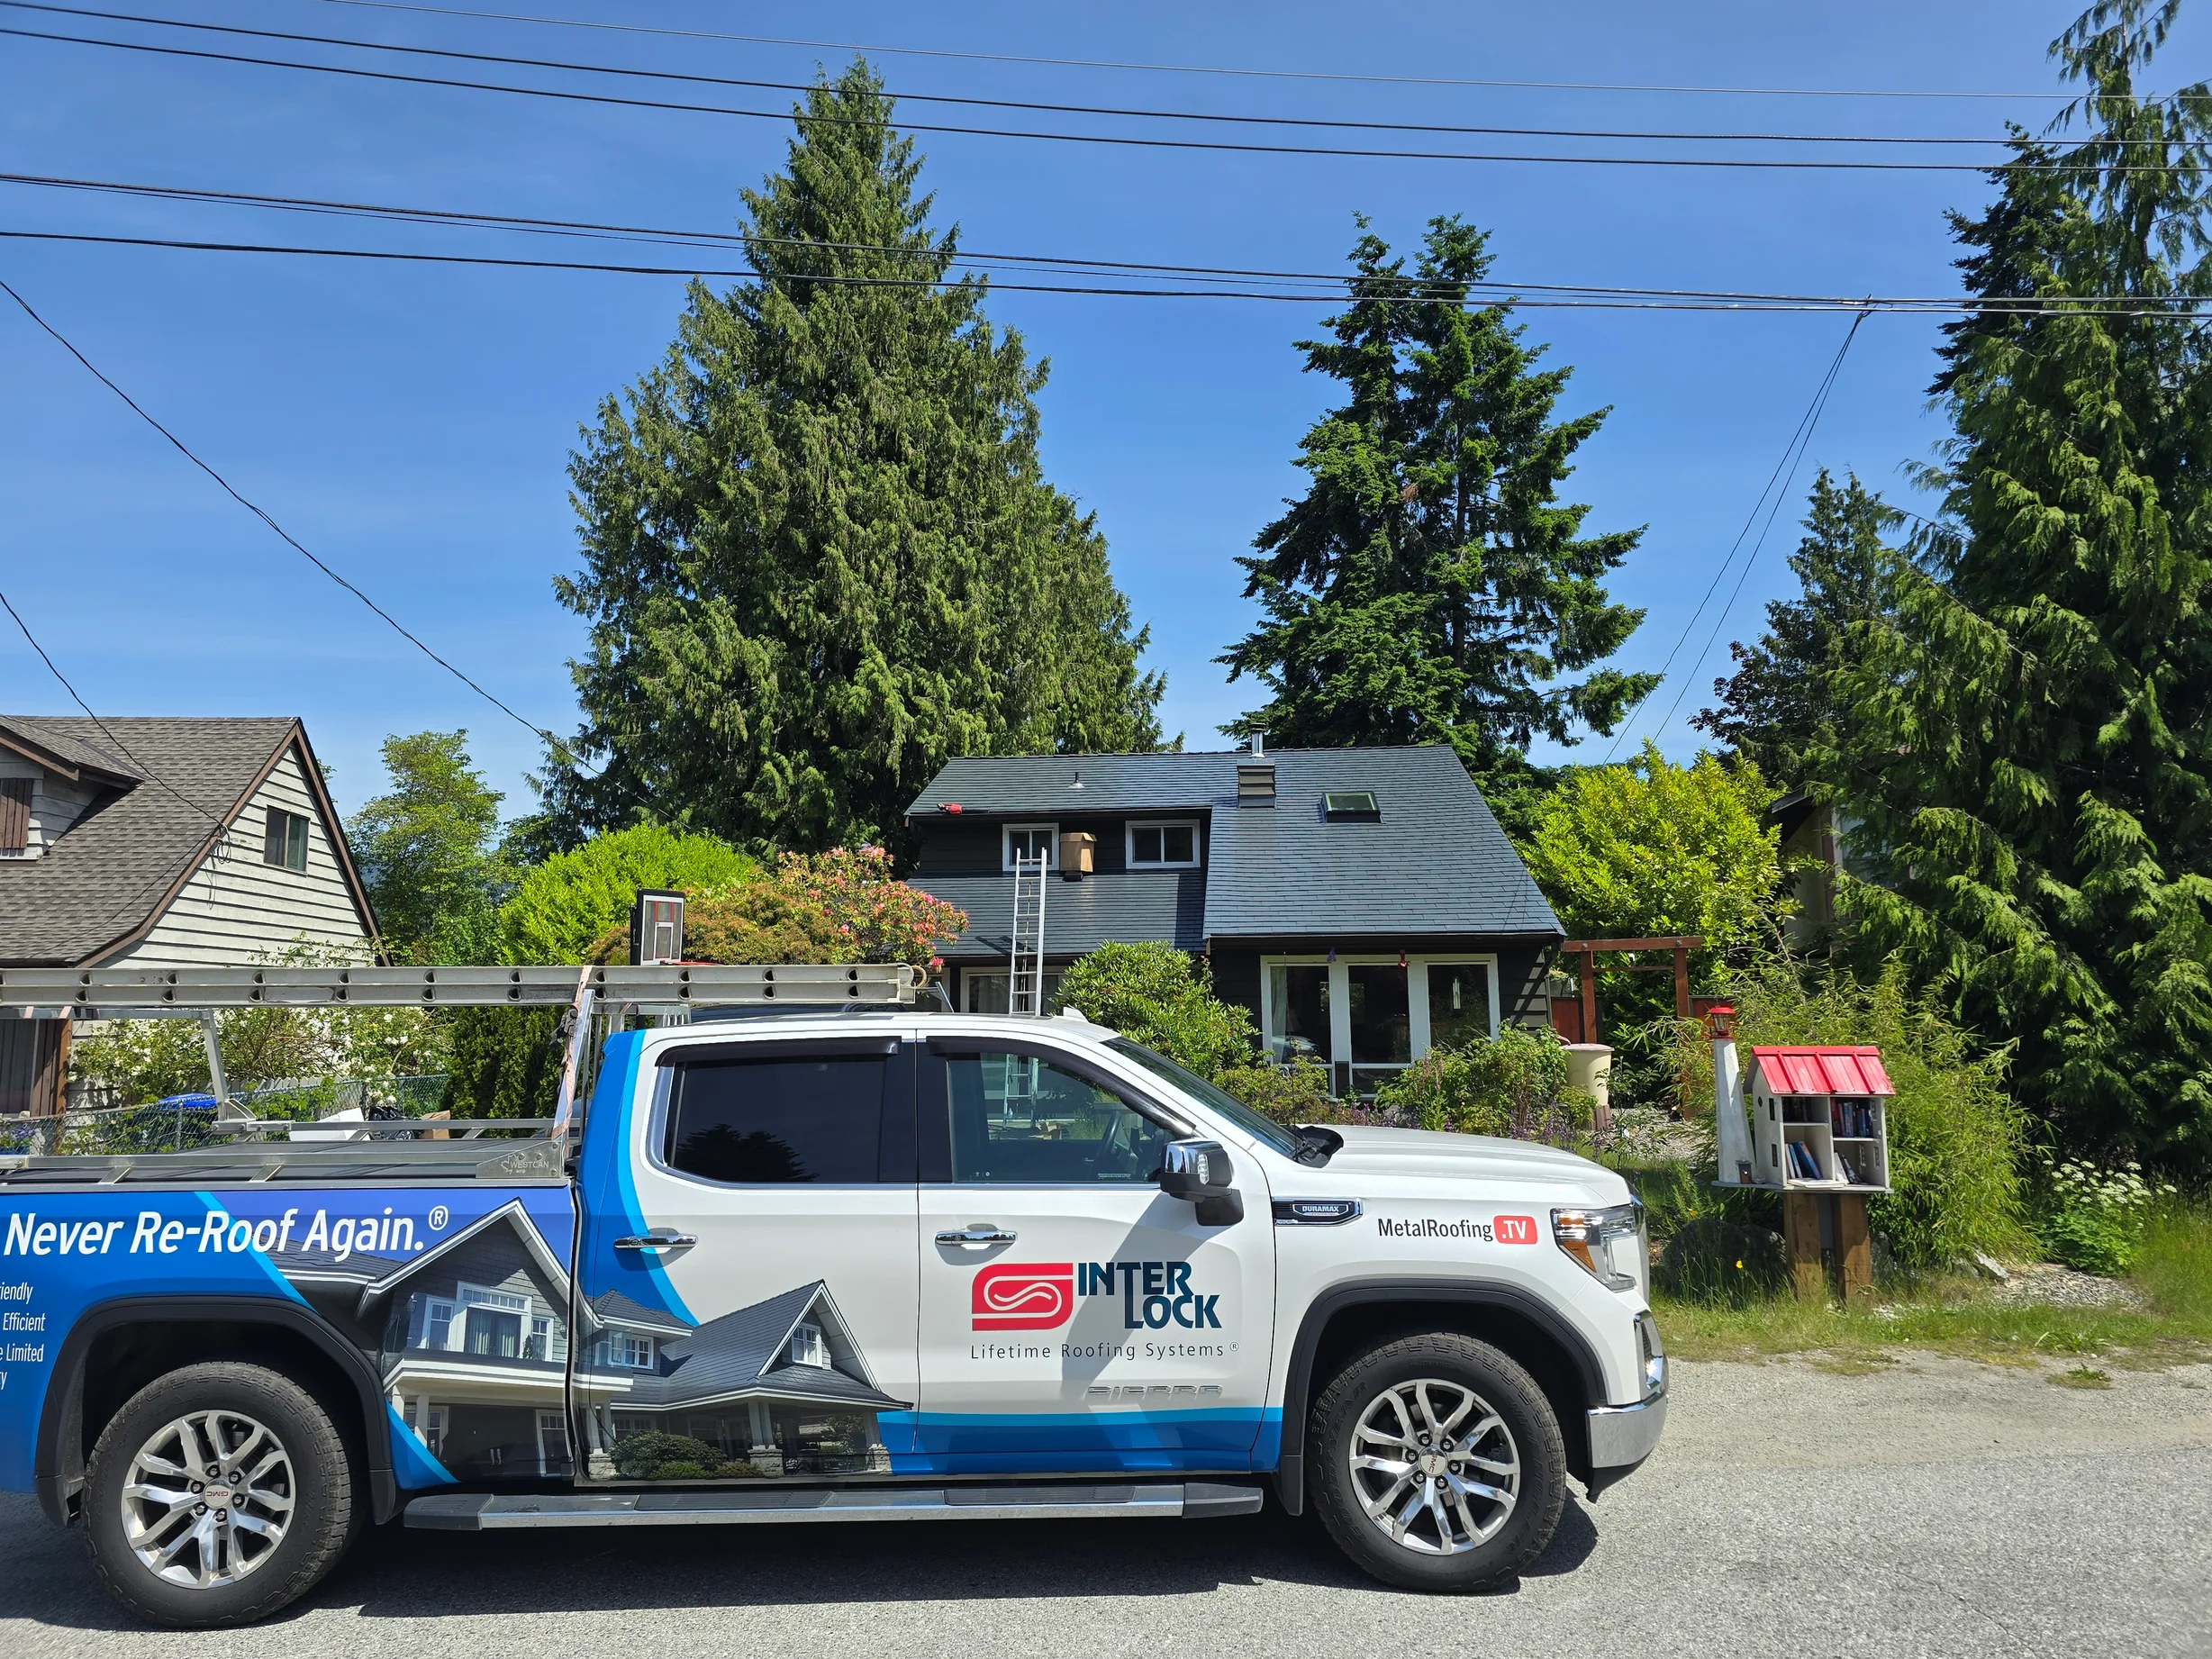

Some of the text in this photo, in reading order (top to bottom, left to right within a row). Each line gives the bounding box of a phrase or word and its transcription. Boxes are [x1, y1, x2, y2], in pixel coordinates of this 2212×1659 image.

[4, 1212, 124, 1256] Never
[130, 1208, 298, 1255] Re-Roof
[1078, 1261, 1195, 1298] INTER
[3, 1312, 46, 1331] Efficient
[1125, 1294, 1223, 1330] LOCK
[5, 1343, 44, 1362] Limited
[971, 1343, 1051, 1360] Lifetime
[1061, 1342, 1136, 1361] Roofing
[1087, 1384, 1223, 1395] SIERRA
